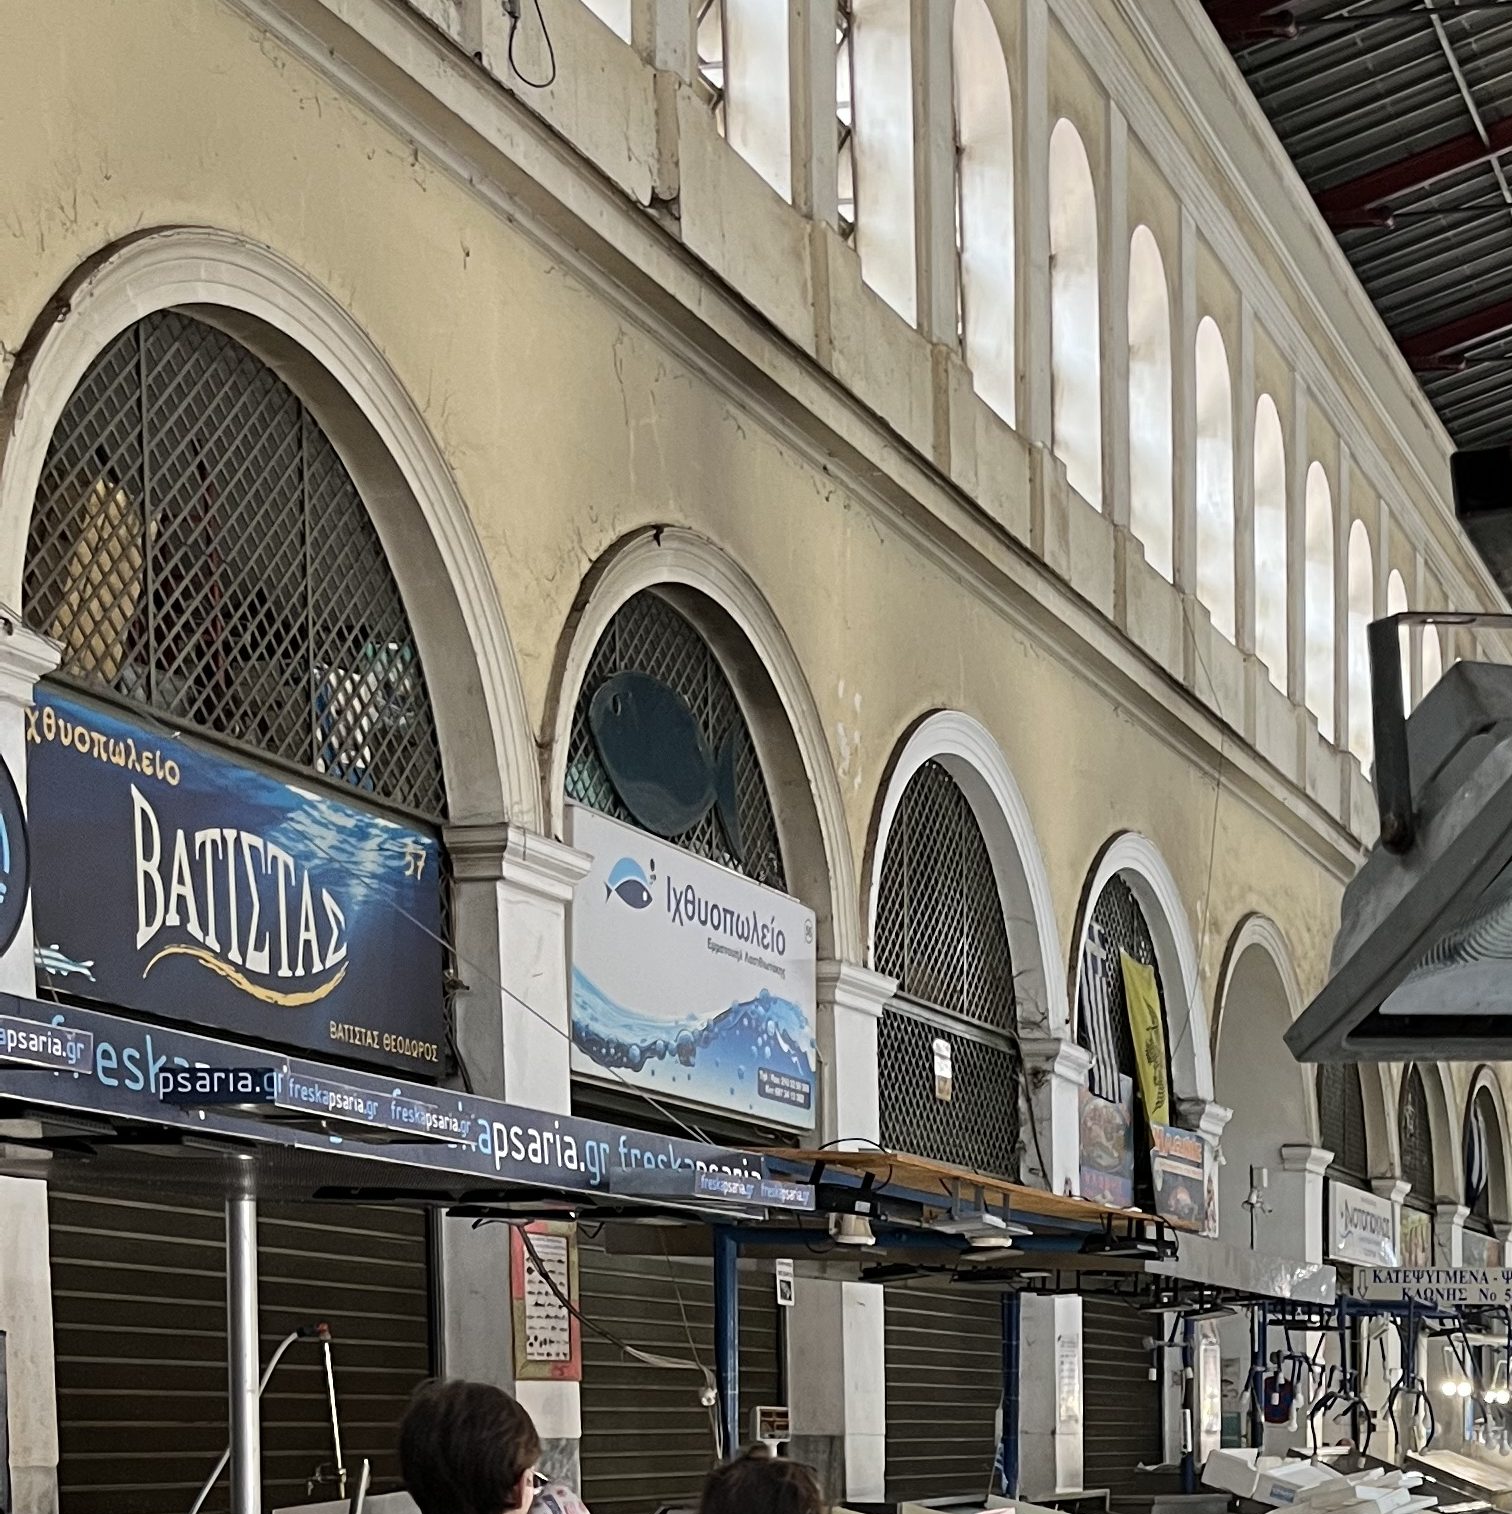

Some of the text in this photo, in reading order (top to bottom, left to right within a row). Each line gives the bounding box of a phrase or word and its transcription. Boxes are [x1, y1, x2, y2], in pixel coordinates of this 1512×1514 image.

[131, 783, 348, 977] ΒΑΤΙΣΤΑΣ
[404, 847, 427, 881] 57
[667, 876, 786, 956] Ιχθυοπωλείο
[330, 1021, 439, 1062] ΒΑΤΙΣΤΑΣ ΘΕΟΔΩΡΟΣ
[289, 1078, 471, 1137] freskapsaria.gr freskapsaria.gr
[1373, 1269, 1489, 1285] ΚΑΤΕΨΥΓΜΕΝΑ
